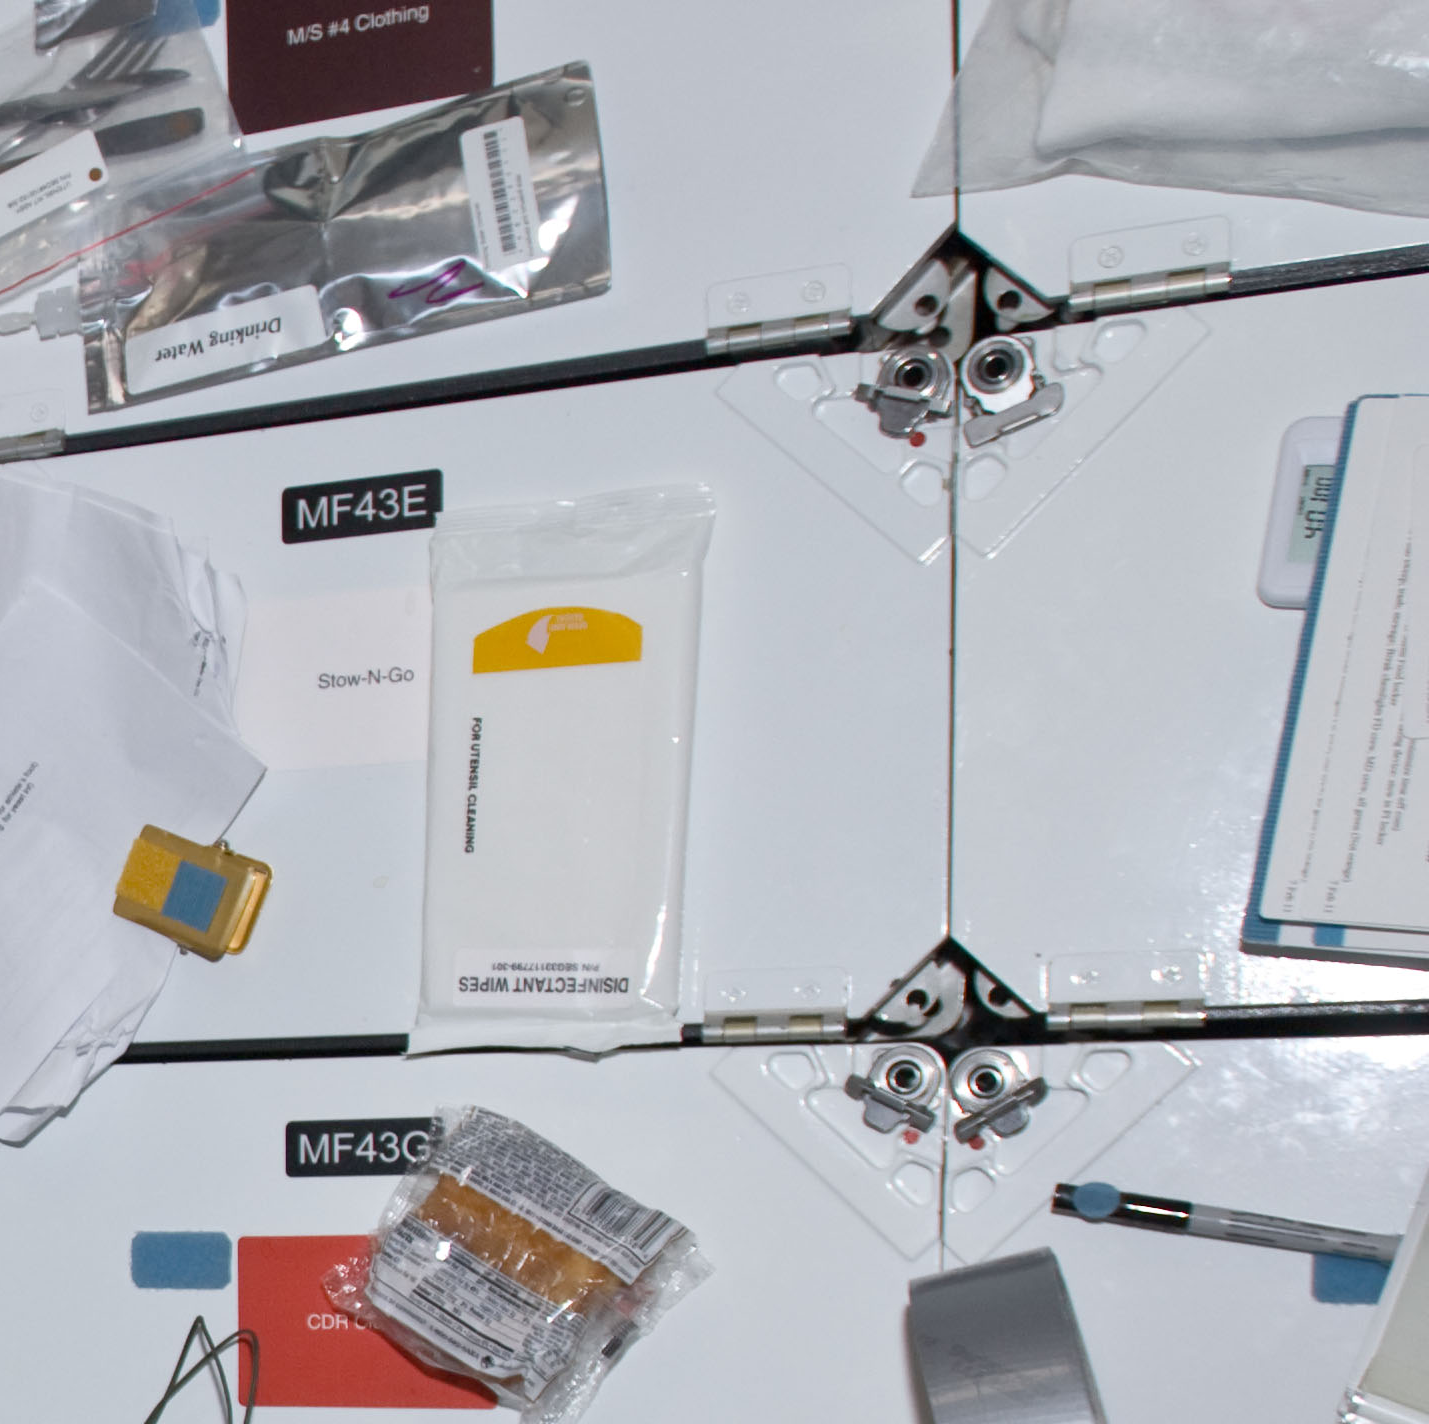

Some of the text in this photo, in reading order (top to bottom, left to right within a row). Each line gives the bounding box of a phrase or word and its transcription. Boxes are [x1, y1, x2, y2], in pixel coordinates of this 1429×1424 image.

[285, 3, 431, 45] M/S #4 Clothing
[152, 316, 283, 365] Drinking Water
[296, 484, 427, 531] MF43E
[317, 667, 415, 690] Stow-N-Go
[463, 717, 482, 854] FOR UTENSIL CLEANING
[457, 974, 628, 994] DISINFECTANT WIPES
[299, 1130, 431, 1164] MF43G
[306, 1312, 349, 1331] CDR
